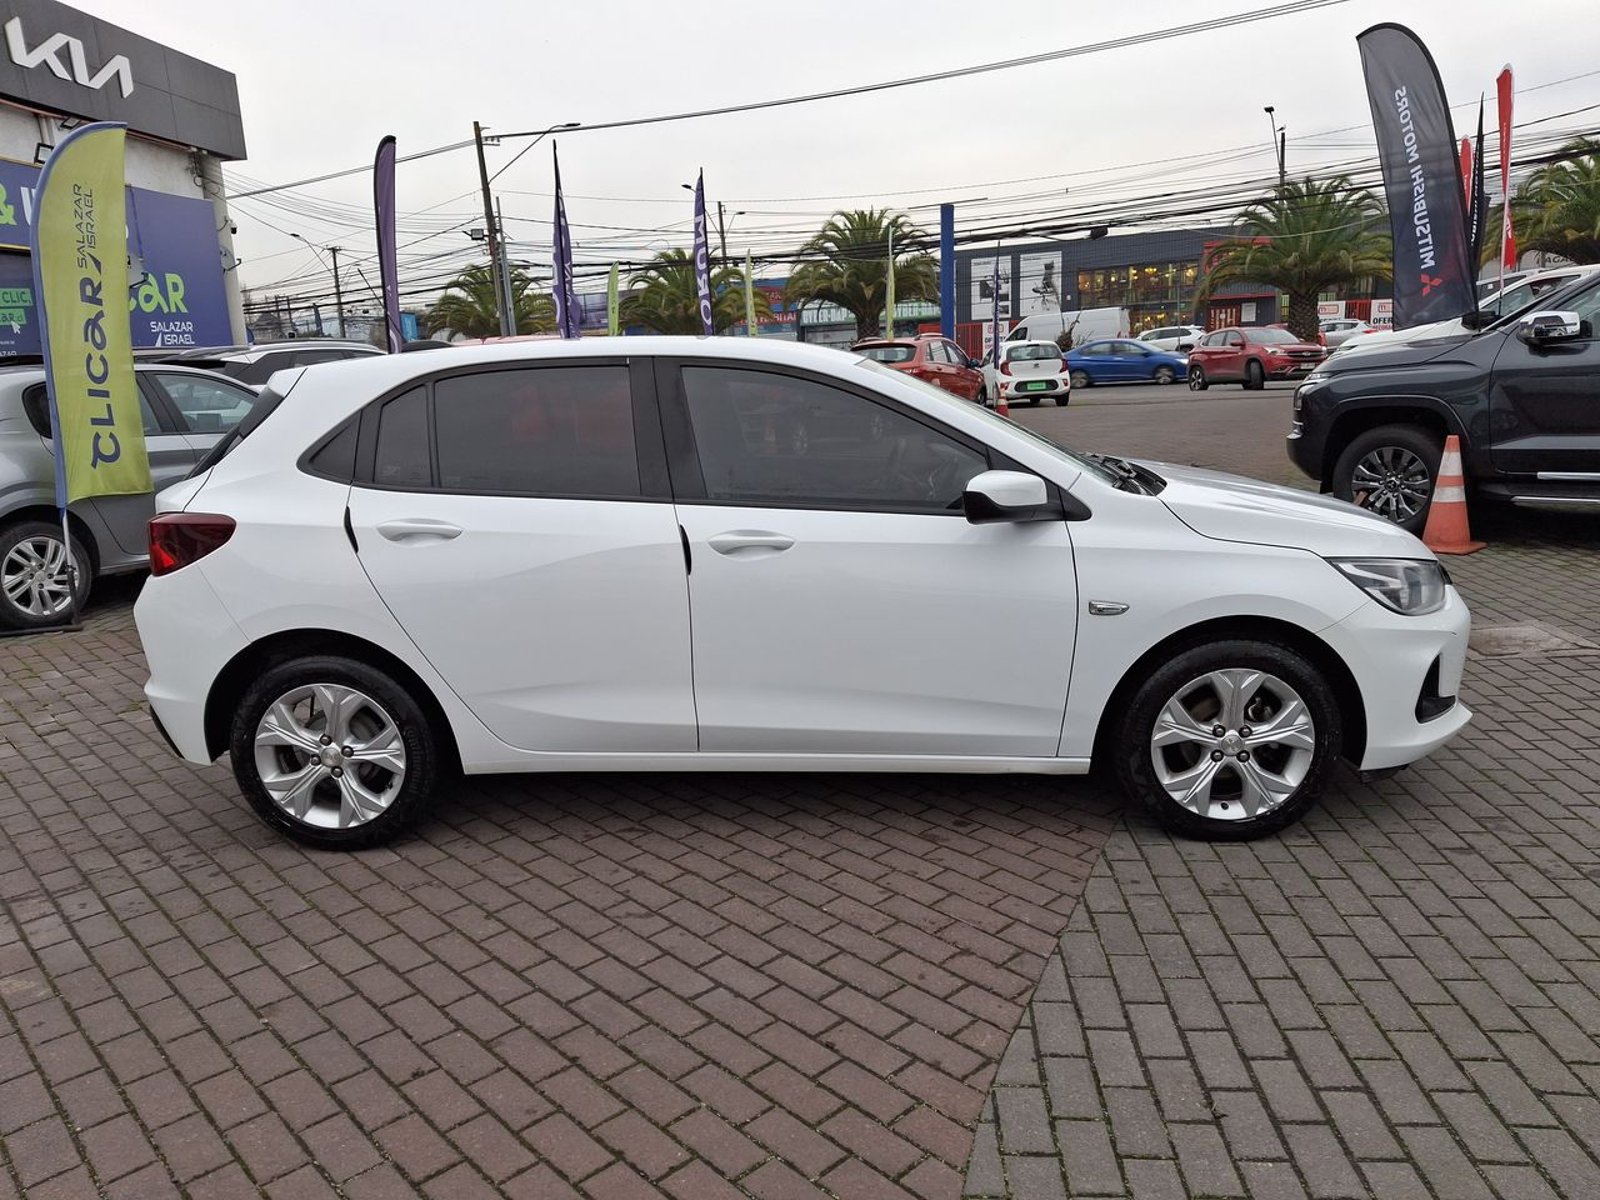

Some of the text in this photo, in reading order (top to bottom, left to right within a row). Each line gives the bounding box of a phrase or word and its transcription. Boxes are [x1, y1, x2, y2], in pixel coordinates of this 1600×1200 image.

[73, 183, 88, 269] SALAZAR
[82, 188, 97, 250] ISRAEL
[150, 321, 194, 332] SALAZAR
[163, 333, 196, 345] ISRAEL
